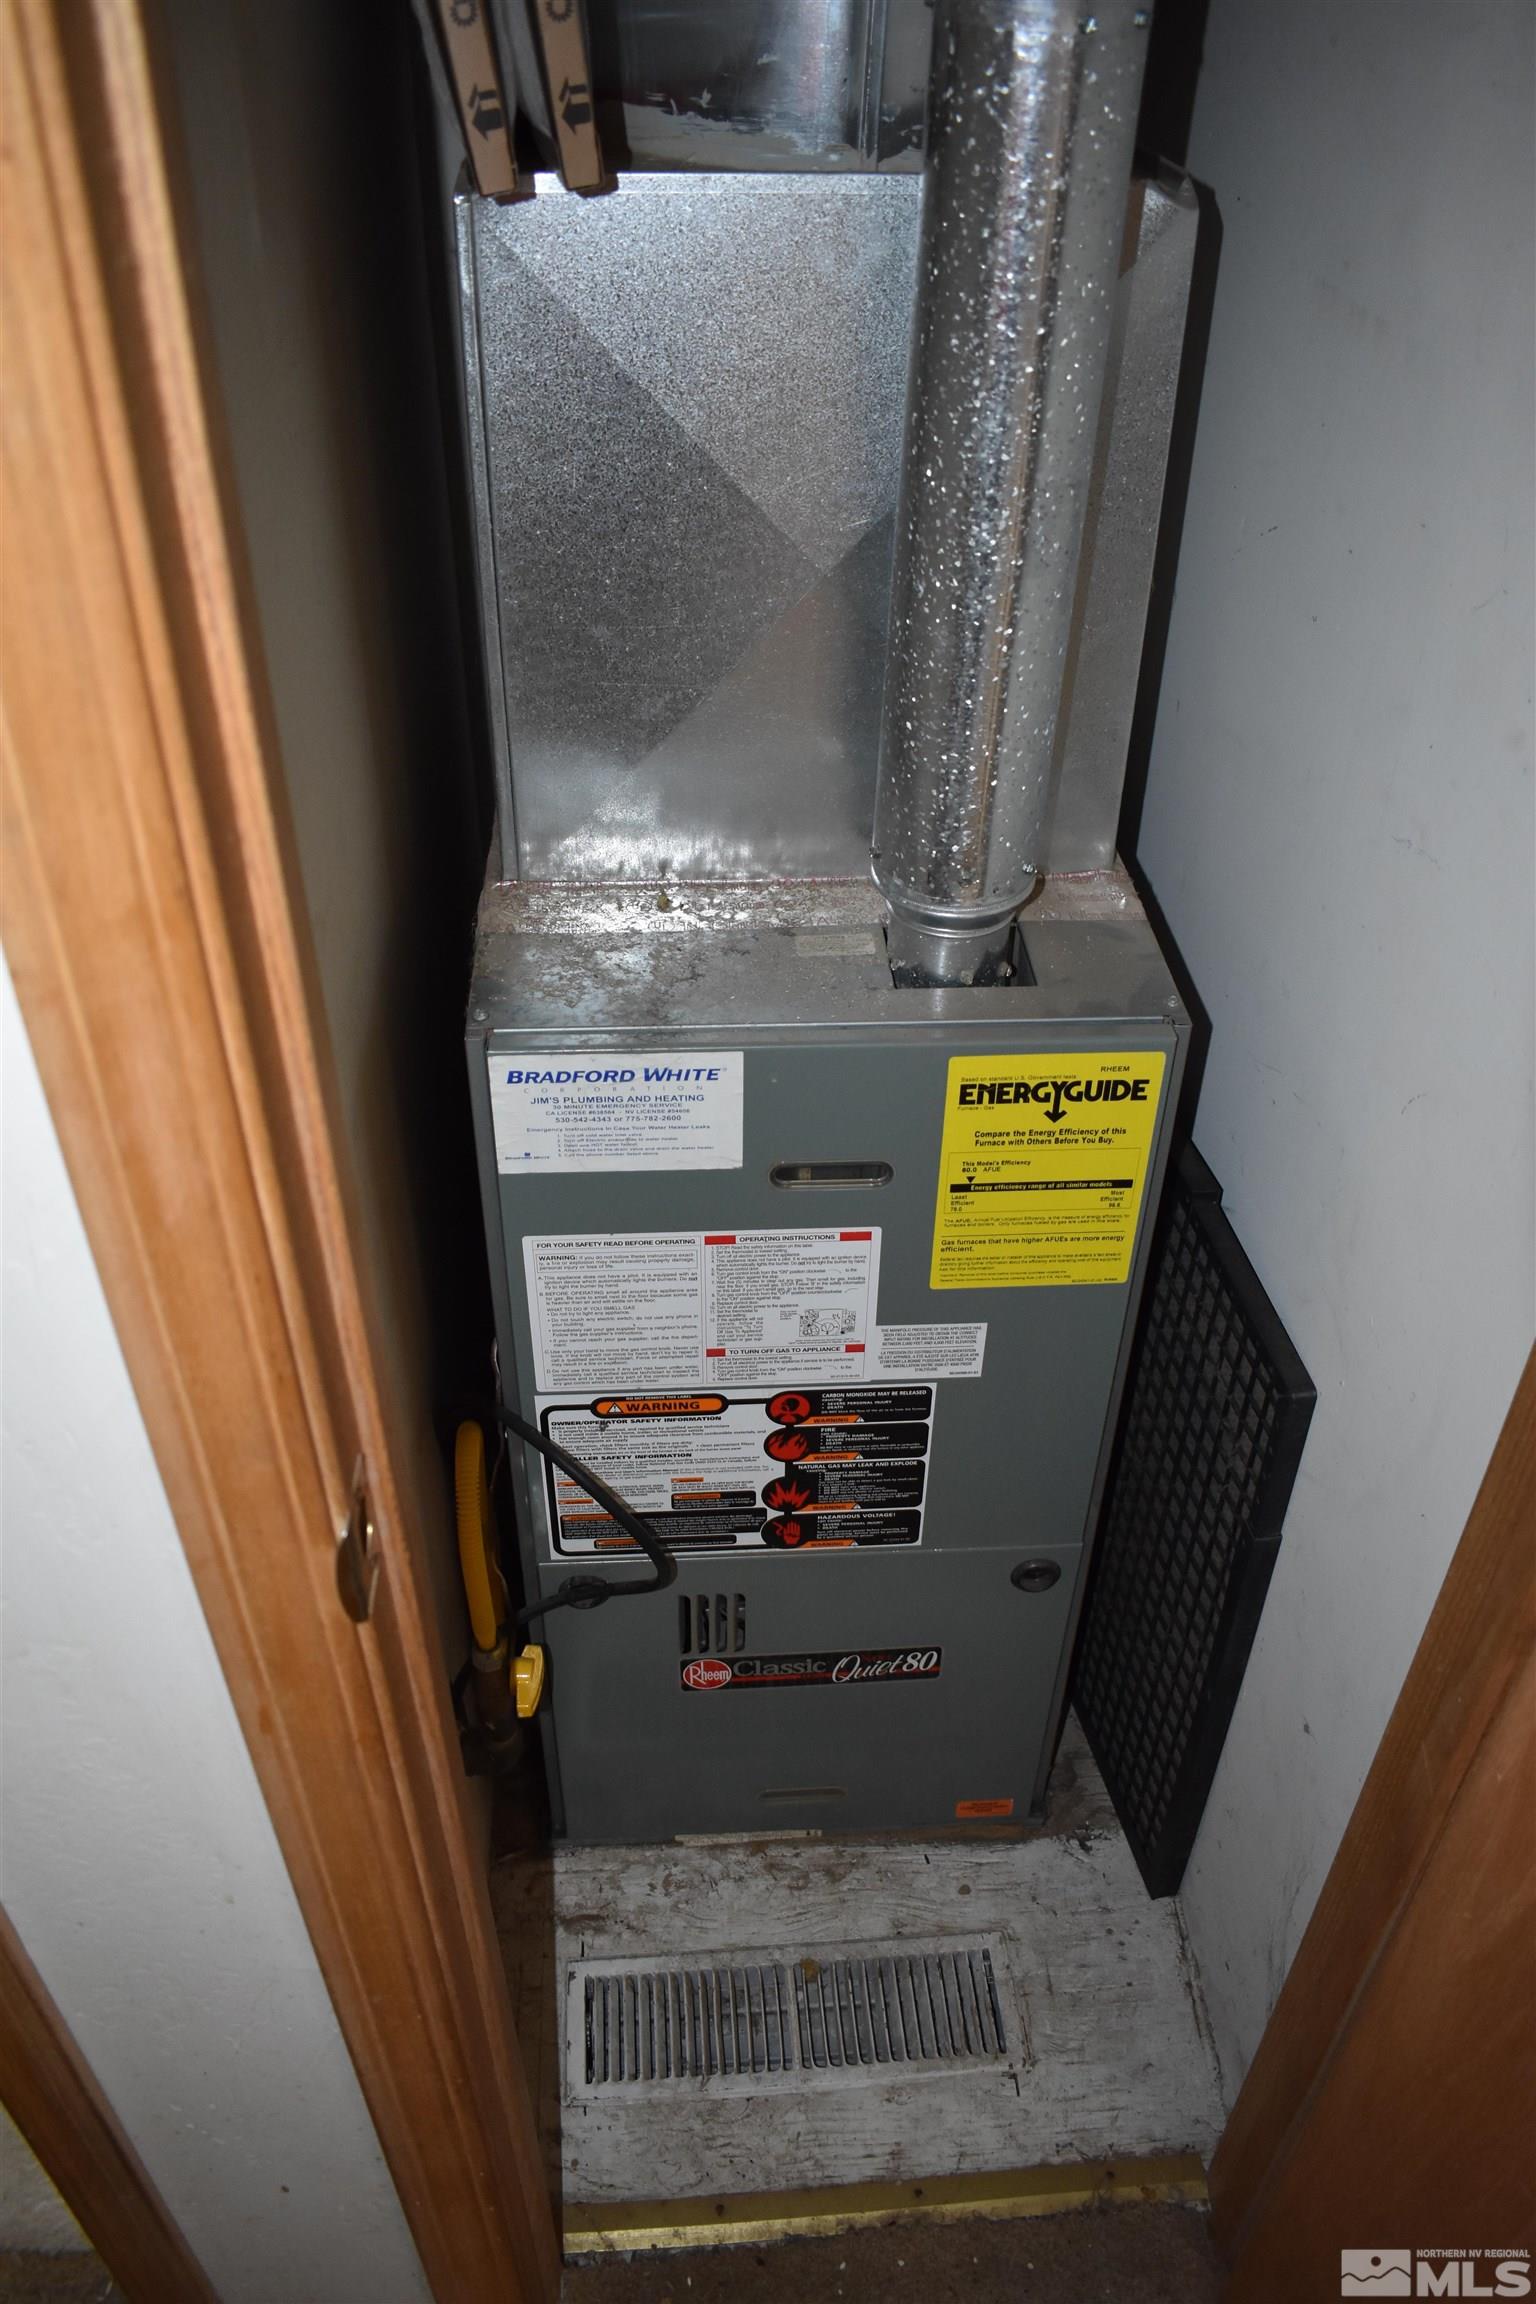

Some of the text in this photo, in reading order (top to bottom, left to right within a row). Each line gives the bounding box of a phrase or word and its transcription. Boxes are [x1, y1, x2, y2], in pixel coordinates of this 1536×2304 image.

[507, 1067, 721, 1084] BRADFORD WHITE
[530, 1094, 705, 1105] JIM'S PLUMBING AND HEATING
[958, 1079, 1150, 1107] ENERGYGUIDE
[974, 1130, 1010, 1139] Compare
[1028, 1129, 1056, 1137] Energy
[1059, 1128, 1099, 1136] Efficiency
[1111, 1127, 1127, 1135] this
[974, 1139, 1006, 1147] Furnace
[1007, 1138, 1025, 1146] with
[1054, 1137, 1079, 1145] Before
[1098, 1136, 1114, 1145] Buy.
[626, 1401, 701, 1412] WARNING
[686, 1660, 731, 1685] Rheem
[732, 1650, 939, 1684] Classic Quiet 80
